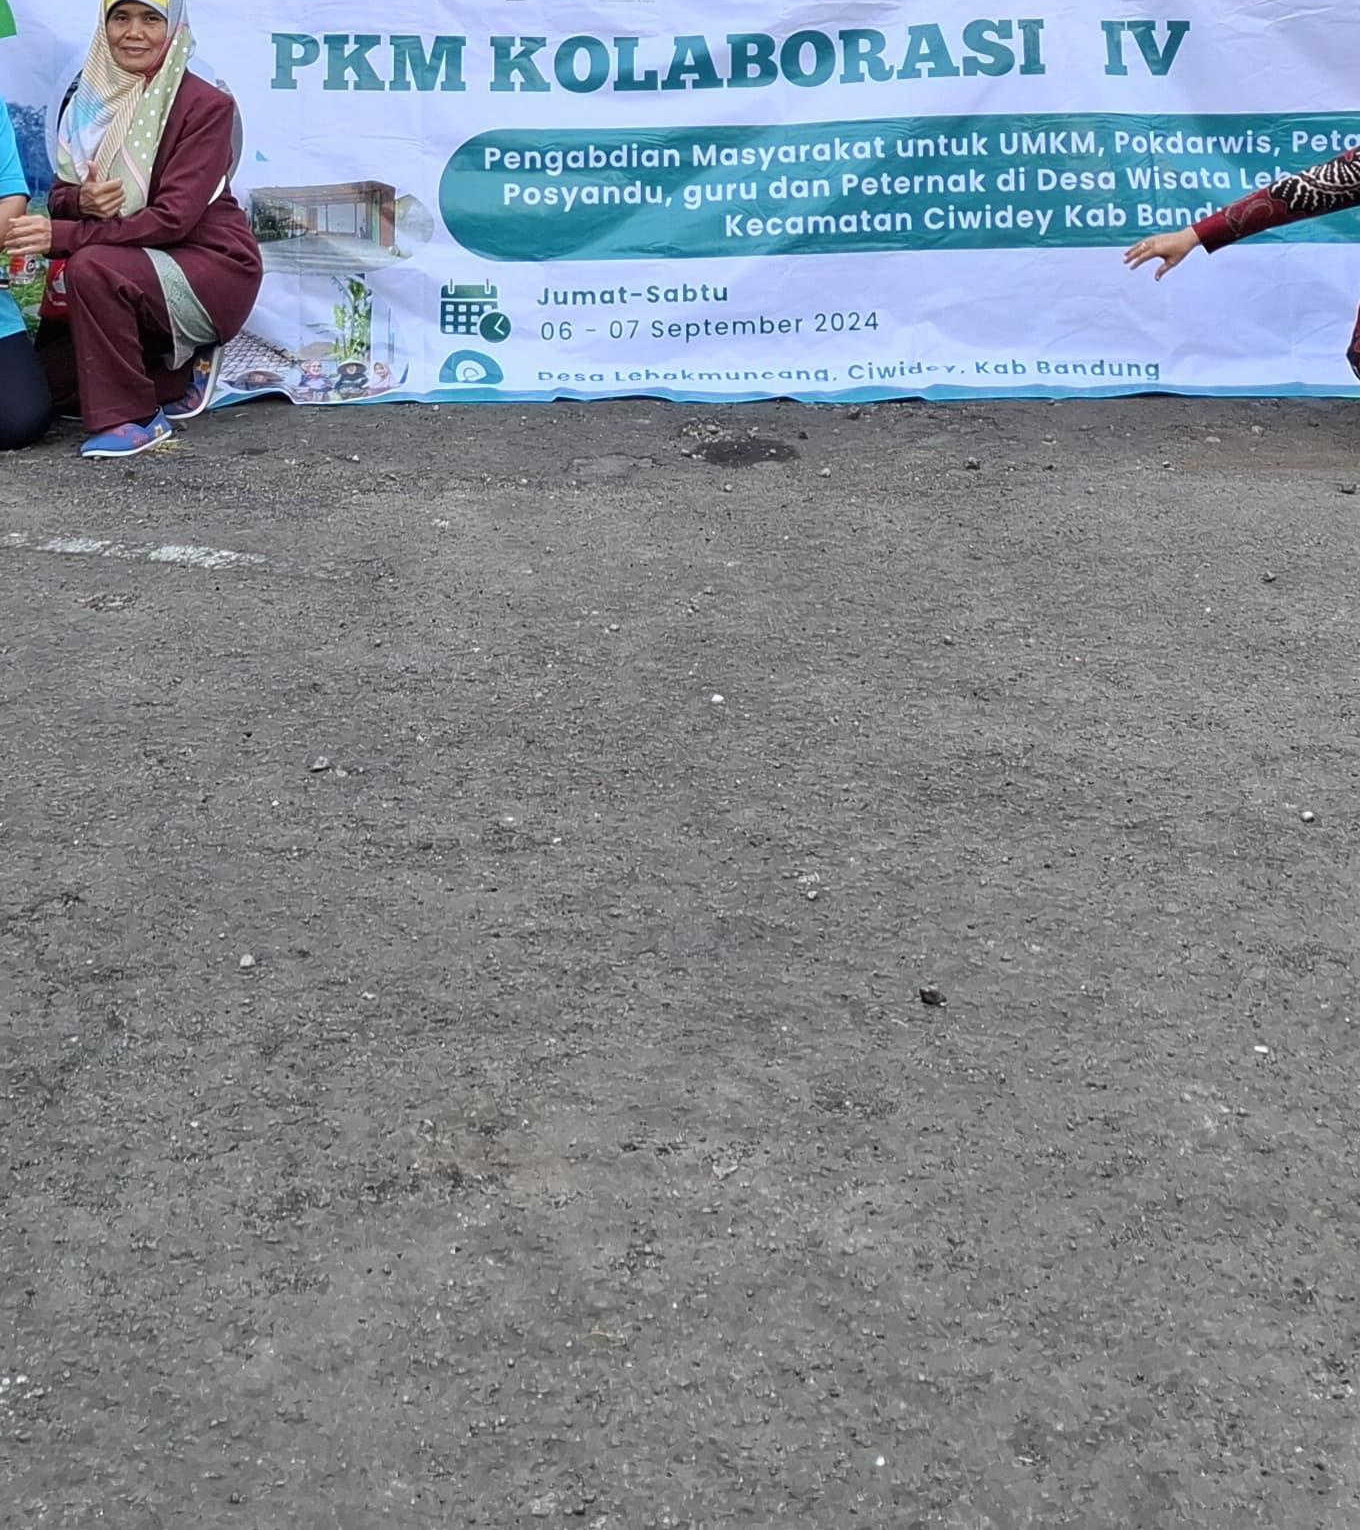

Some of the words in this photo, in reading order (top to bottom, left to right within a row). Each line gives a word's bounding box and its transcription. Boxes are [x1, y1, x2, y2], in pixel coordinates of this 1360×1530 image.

[270, 32, 467, 92] PKM
[489, 18, 1046, 94] KOLABORASI
[1100, 20, 1191, 76] IV
[484, 143, 681, 175] Pengabdian
[692, 138, 886, 171] Masyarakat
[896, 131, 989, 158] untuk
[999, 131, 1104, 157] UMKM,
[1115, 129, 1280, 158] Pokdarwis,
[503, 181, 673, 212] Posyandu,
[683, 179, 757, 209] guru
[768, 173, 830, 199] dan
[842, 168, 985, 197] Peternak
[996, 167, 1026, 193] di
[1038, 168, 1116, 192] Desa
[1126, 165, 1231, 191] Wisata
[725, 209, 913, 237] Kecamatan
[924, 204, 1053, 235] Ciwidey
[1065, 203, 1127, 228] Kab
[537, 284, 729, 306] Jumat-Sabtu
[540, 320, 573, 341] 06
[609, 319, 639, 339] 07
[651, 316, 803, 343] September
[814, 311, 880, 333] 2024
[538, 371, 605, 382] Desa
[975, 360, 1027, 376] Kab
[1036, 360, 1161, 381] Bandung
